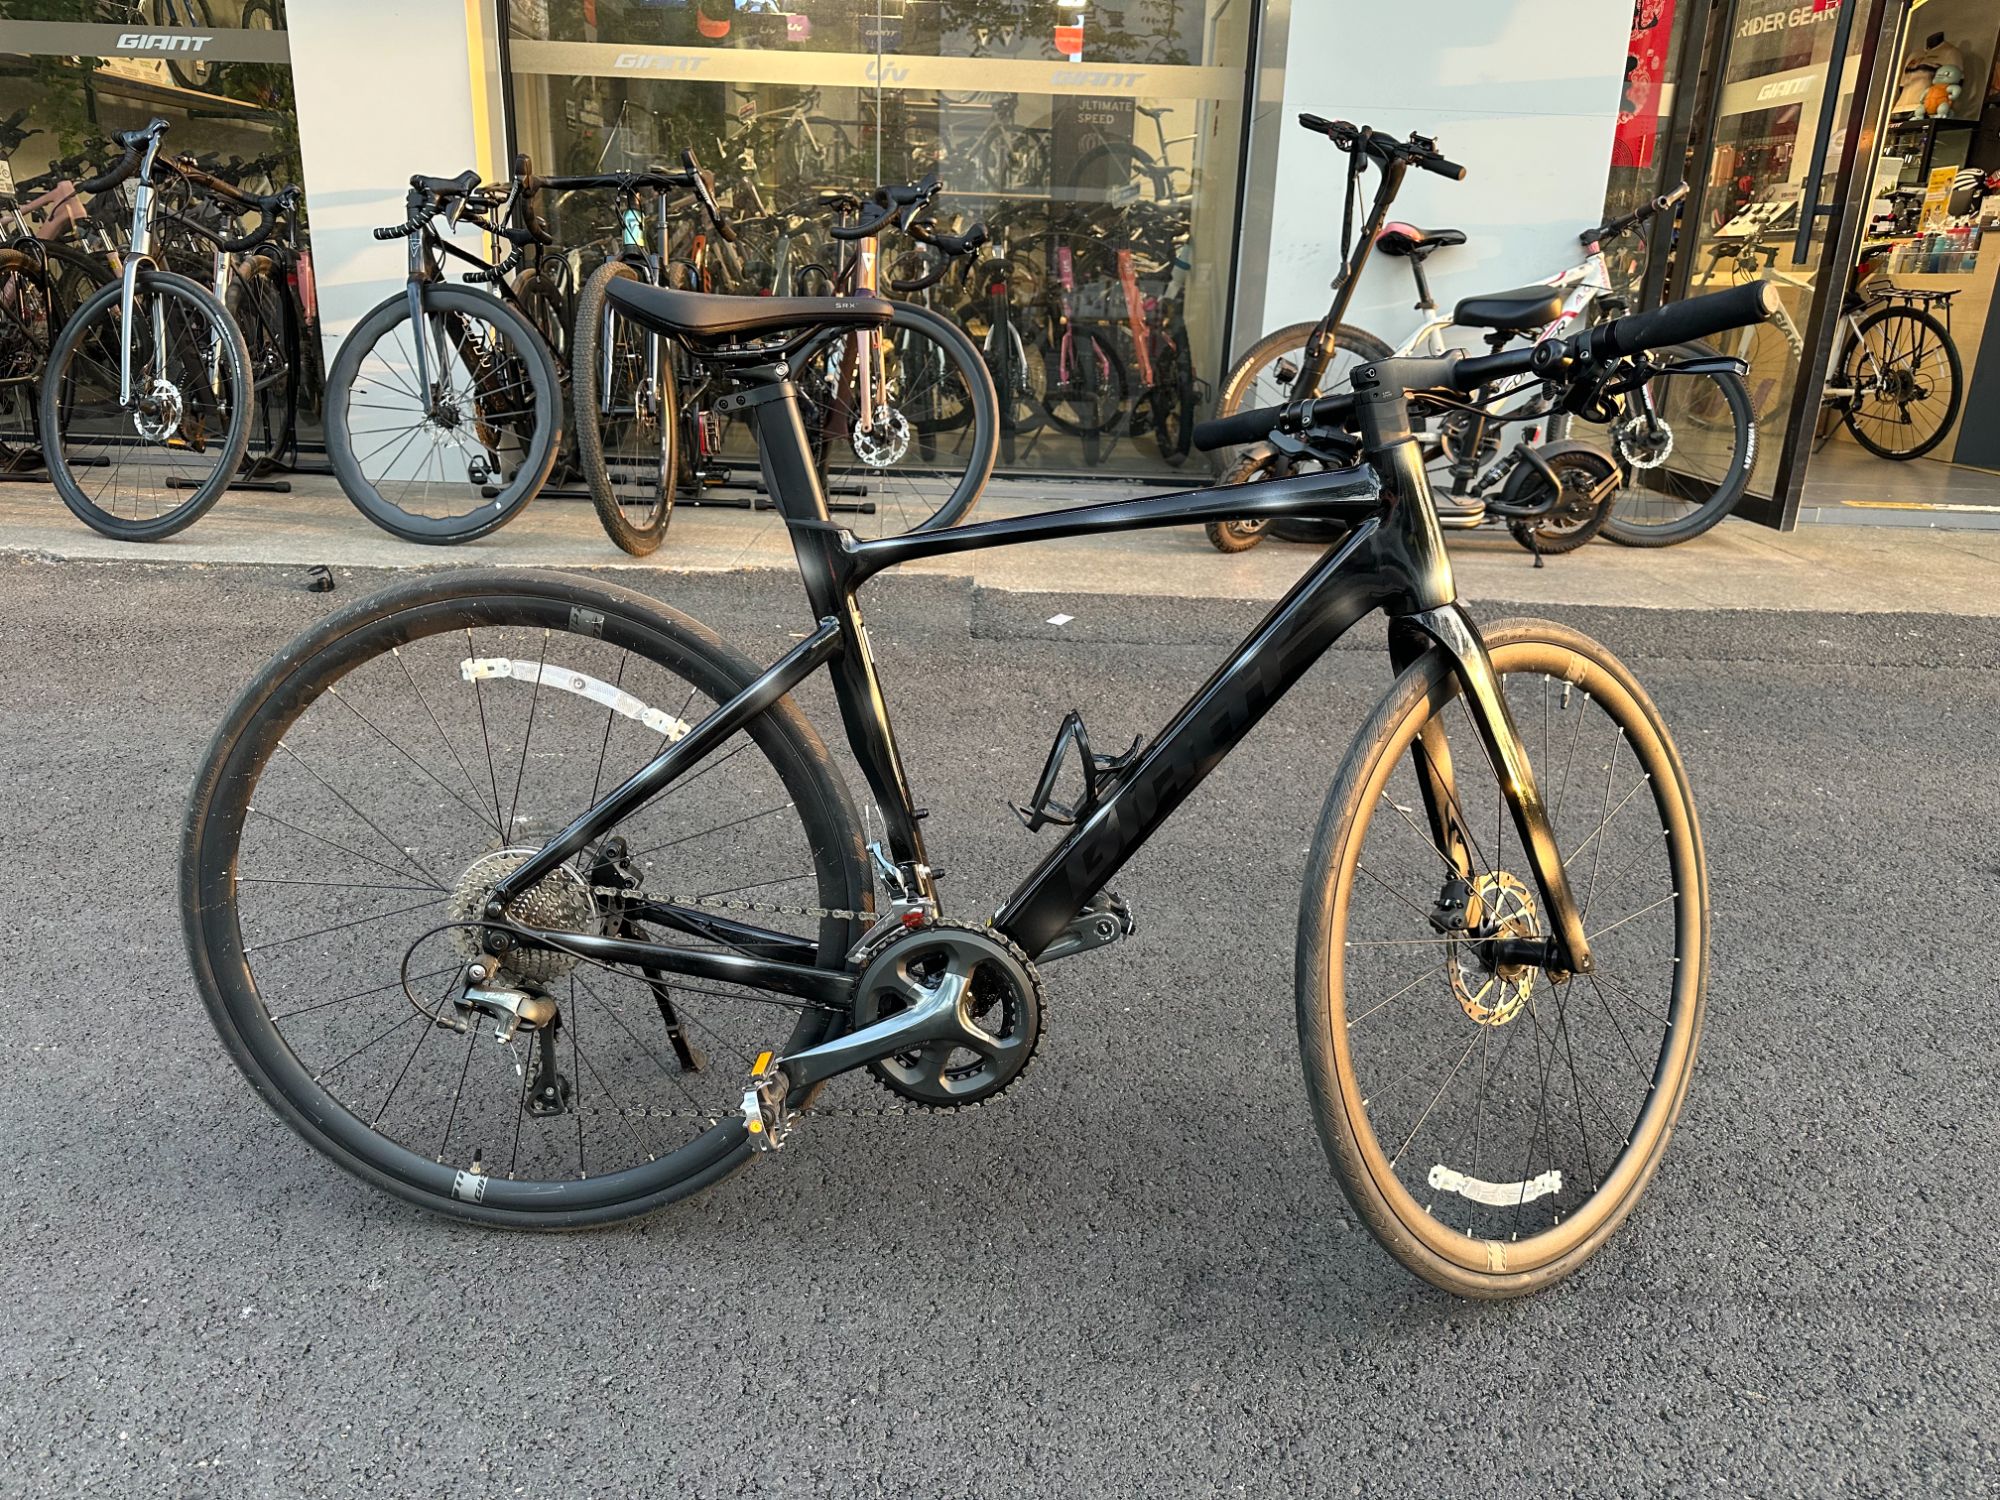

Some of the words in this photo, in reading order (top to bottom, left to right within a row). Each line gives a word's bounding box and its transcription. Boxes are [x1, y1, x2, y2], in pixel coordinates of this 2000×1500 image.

[1737, 12, 1785, 38] RIDER
[116, 33, 214, 52] GIANT
[614, 53, 710, 72] GIANT
[865, 61, 910, 81] Liv
[1051, 70, 1147, 89] GIANT
[1757, 75, 1818, 101] GIANT
[1077, 113, 1115, 125] SPEED
[1065, 611, 1297, 899] GIANT
